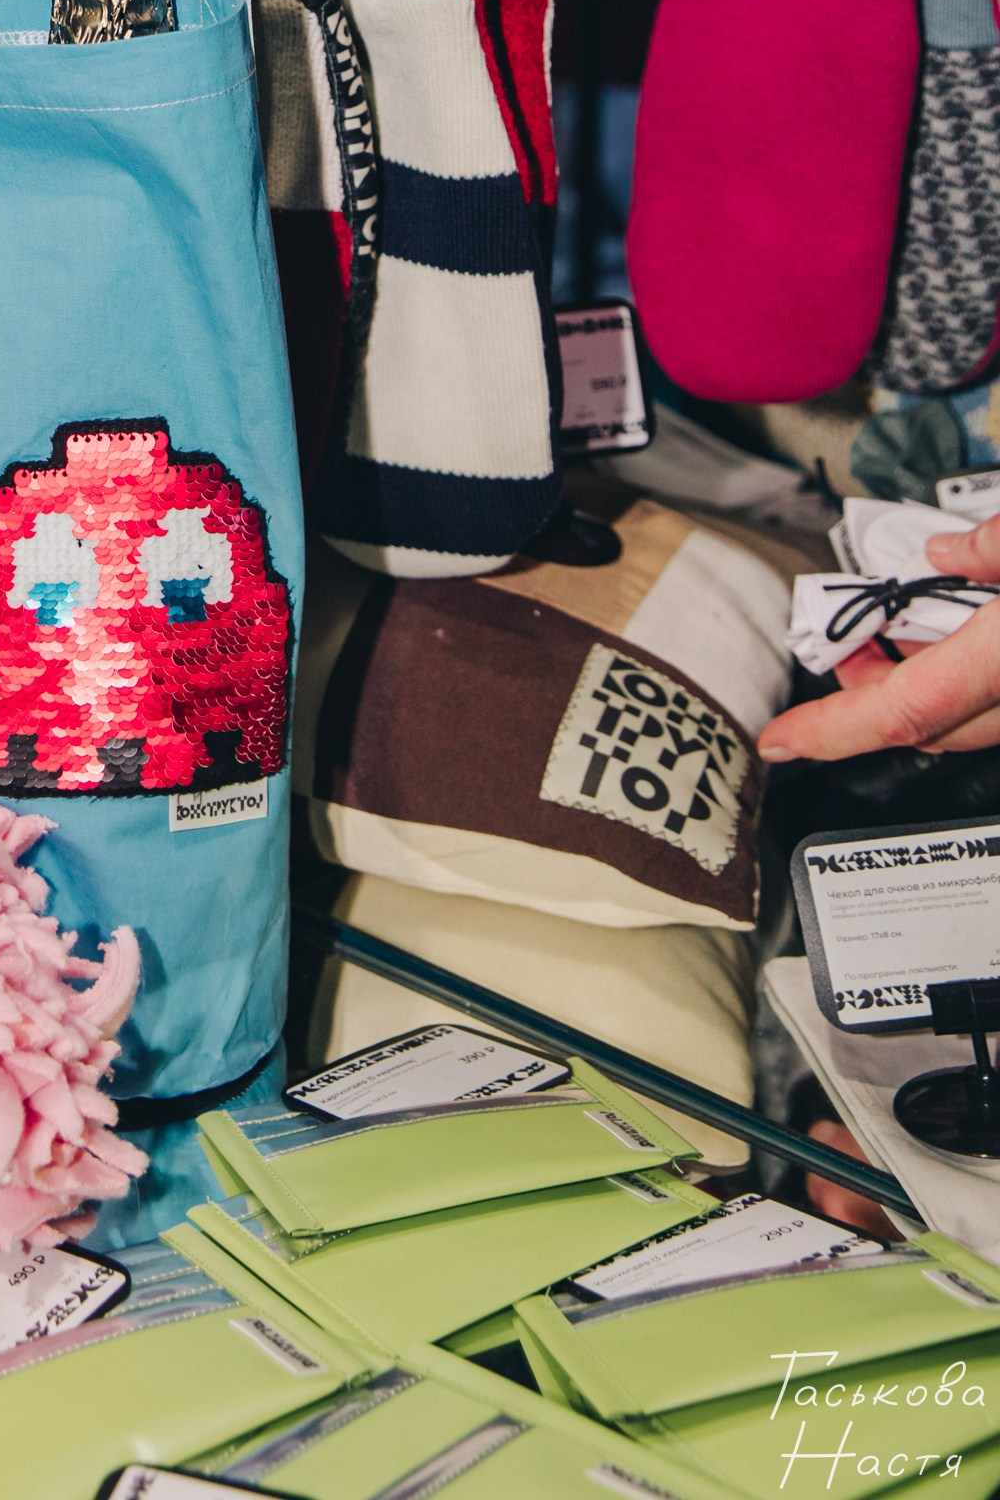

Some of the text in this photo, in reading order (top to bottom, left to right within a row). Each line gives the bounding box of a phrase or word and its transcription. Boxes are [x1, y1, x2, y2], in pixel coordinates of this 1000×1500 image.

[578, 732, 712, 835] ТОР
[176, 793, 264, 821] КОНСТРУКТОР
[827, 890, 861, 899] Чехол
[864, 887, 884, 897] для
[887, 884, 919, 894] очков
[922, 882, 935, 890] из
[760, 1225, 792, 1241] 290
[8, 1265, 37, 1287] 490
